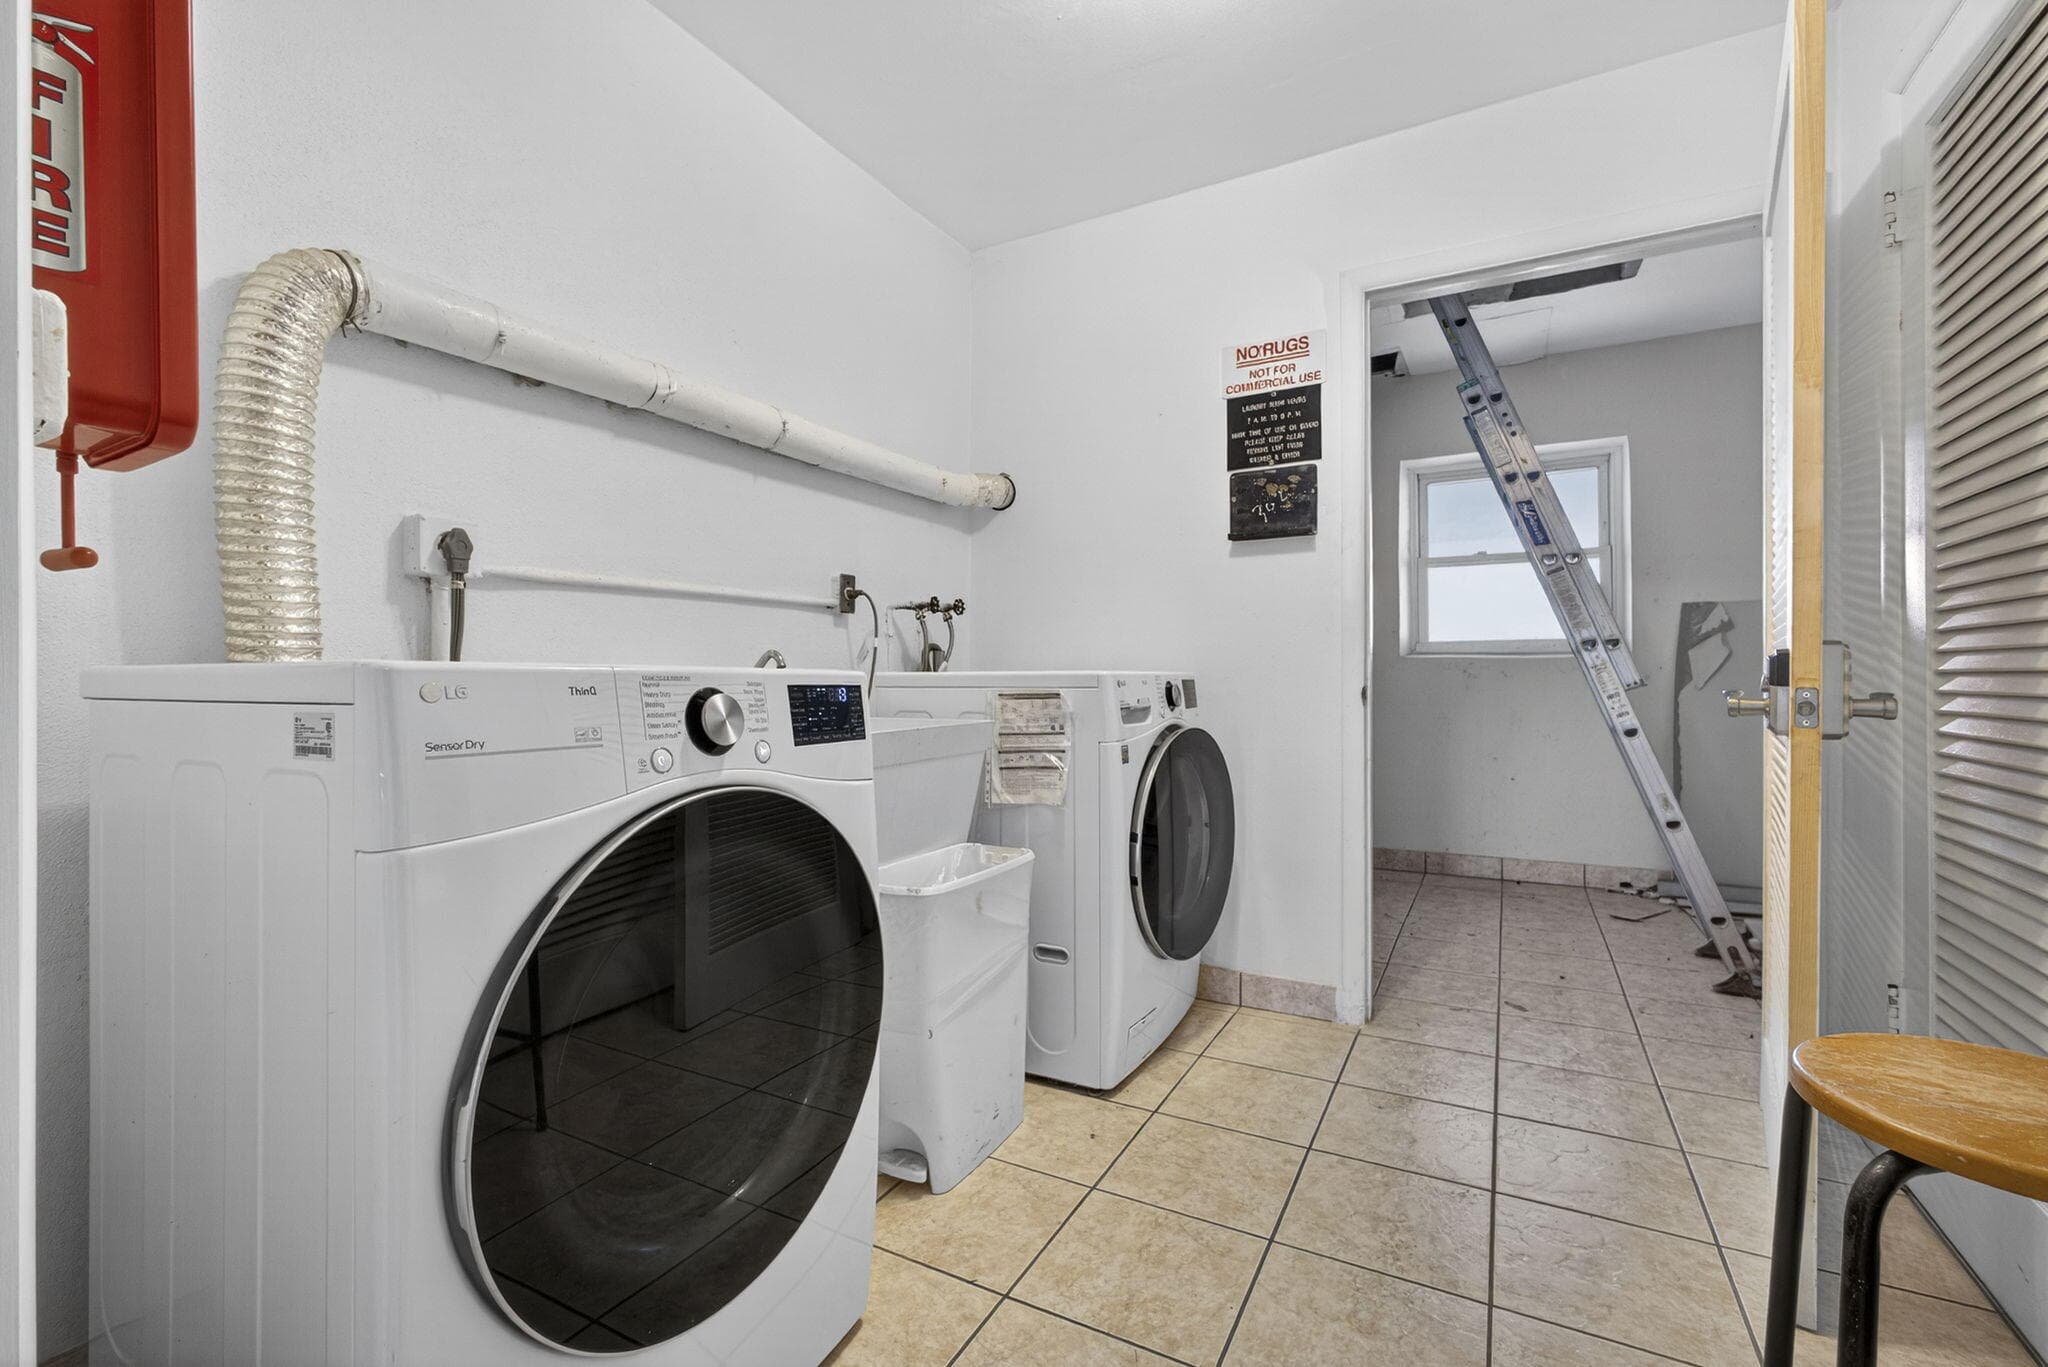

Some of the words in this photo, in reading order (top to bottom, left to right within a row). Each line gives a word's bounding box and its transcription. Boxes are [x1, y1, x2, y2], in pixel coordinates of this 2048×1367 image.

[32, 67, 72, 257] FIRE
[1262, 336, 1309, 357] RUGS
[1249, 367, 1270, 379] NOT
[1274, 363, 1296, 375] FOR
[1226, 376, 1296, 395] COMMERCIAL
[1299, 370, 1322, 383] USE
[444, 686, 468, 700] LG
[568, 686, 597, 696] ThinQ
[425, 742, 464, 752] Sensor
[465, 740, 485, 751] Dry
